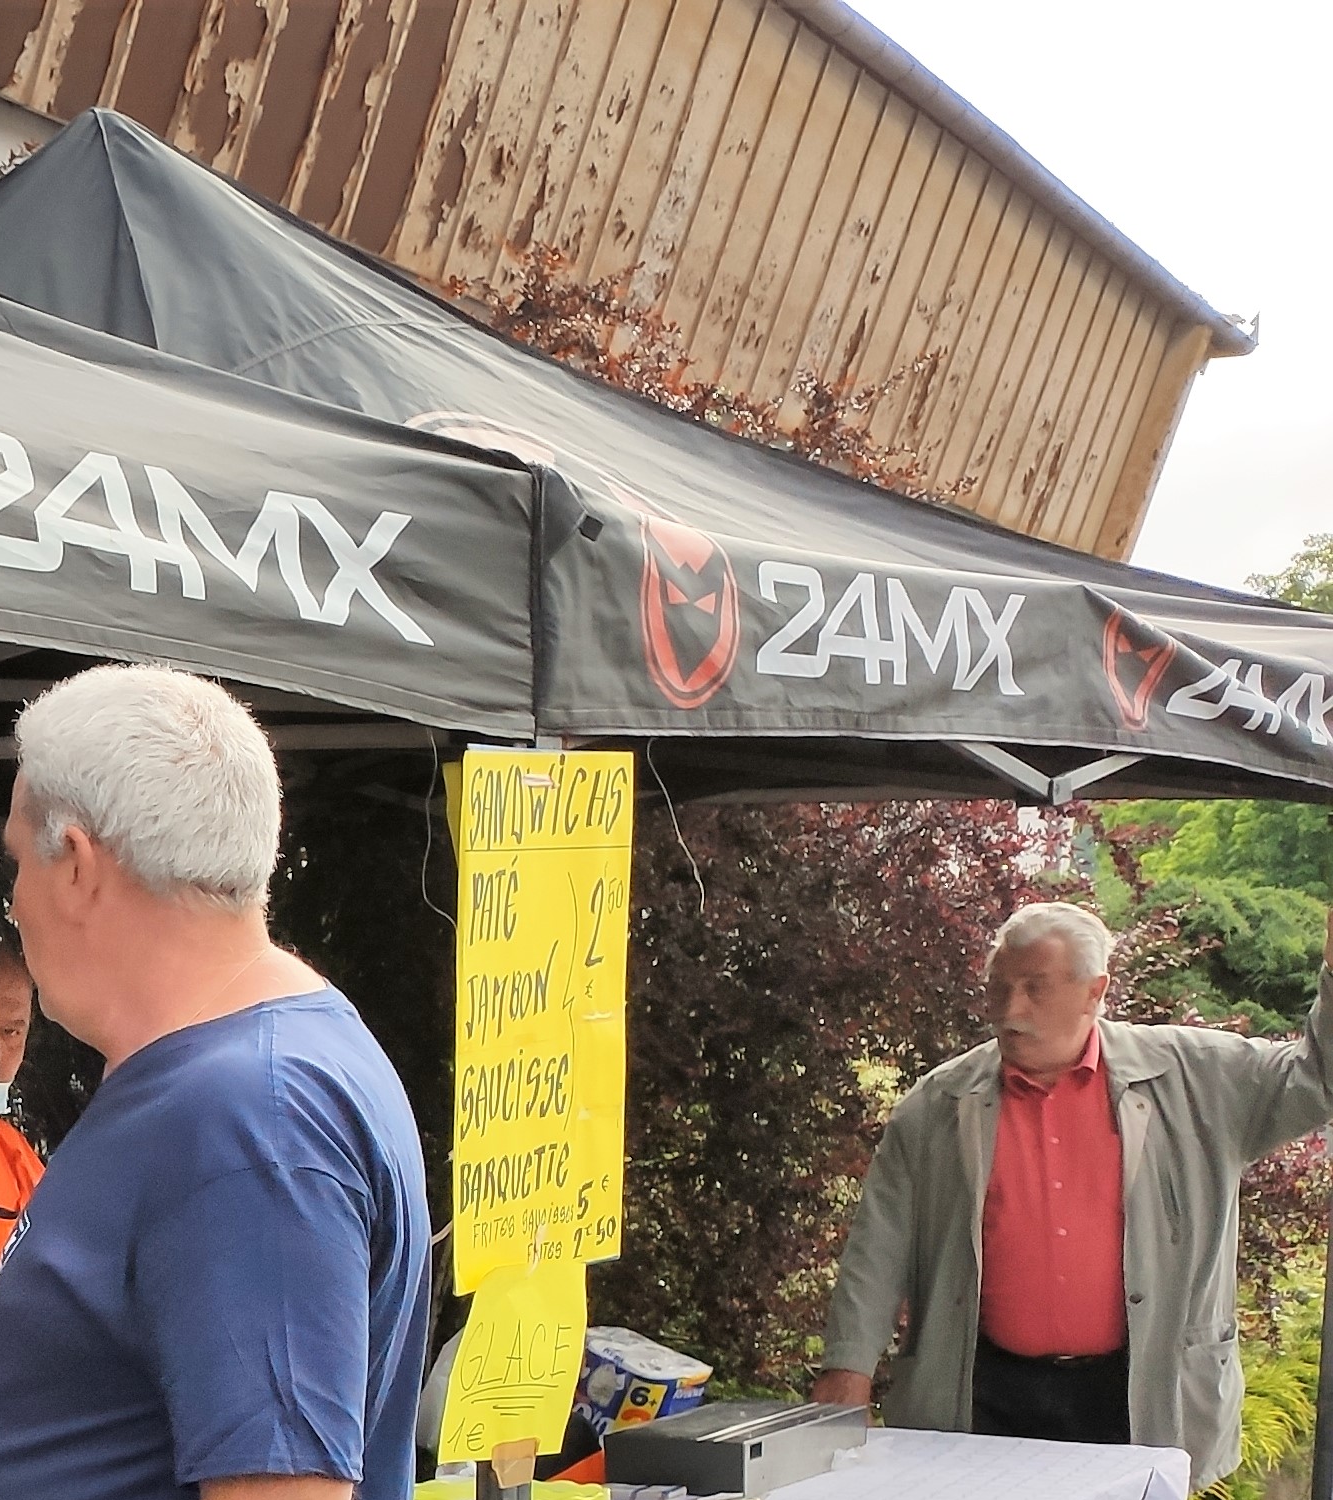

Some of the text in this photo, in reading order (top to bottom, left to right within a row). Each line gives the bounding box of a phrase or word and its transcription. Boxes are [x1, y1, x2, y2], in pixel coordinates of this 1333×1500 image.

[756, 560, 1025, 696] 24MX
[465, 939, 559, 1046] JAMBON
[459, 1141, 570, 1219] BARQUETTE
[460, 1319, 572, 1391] GLACE
